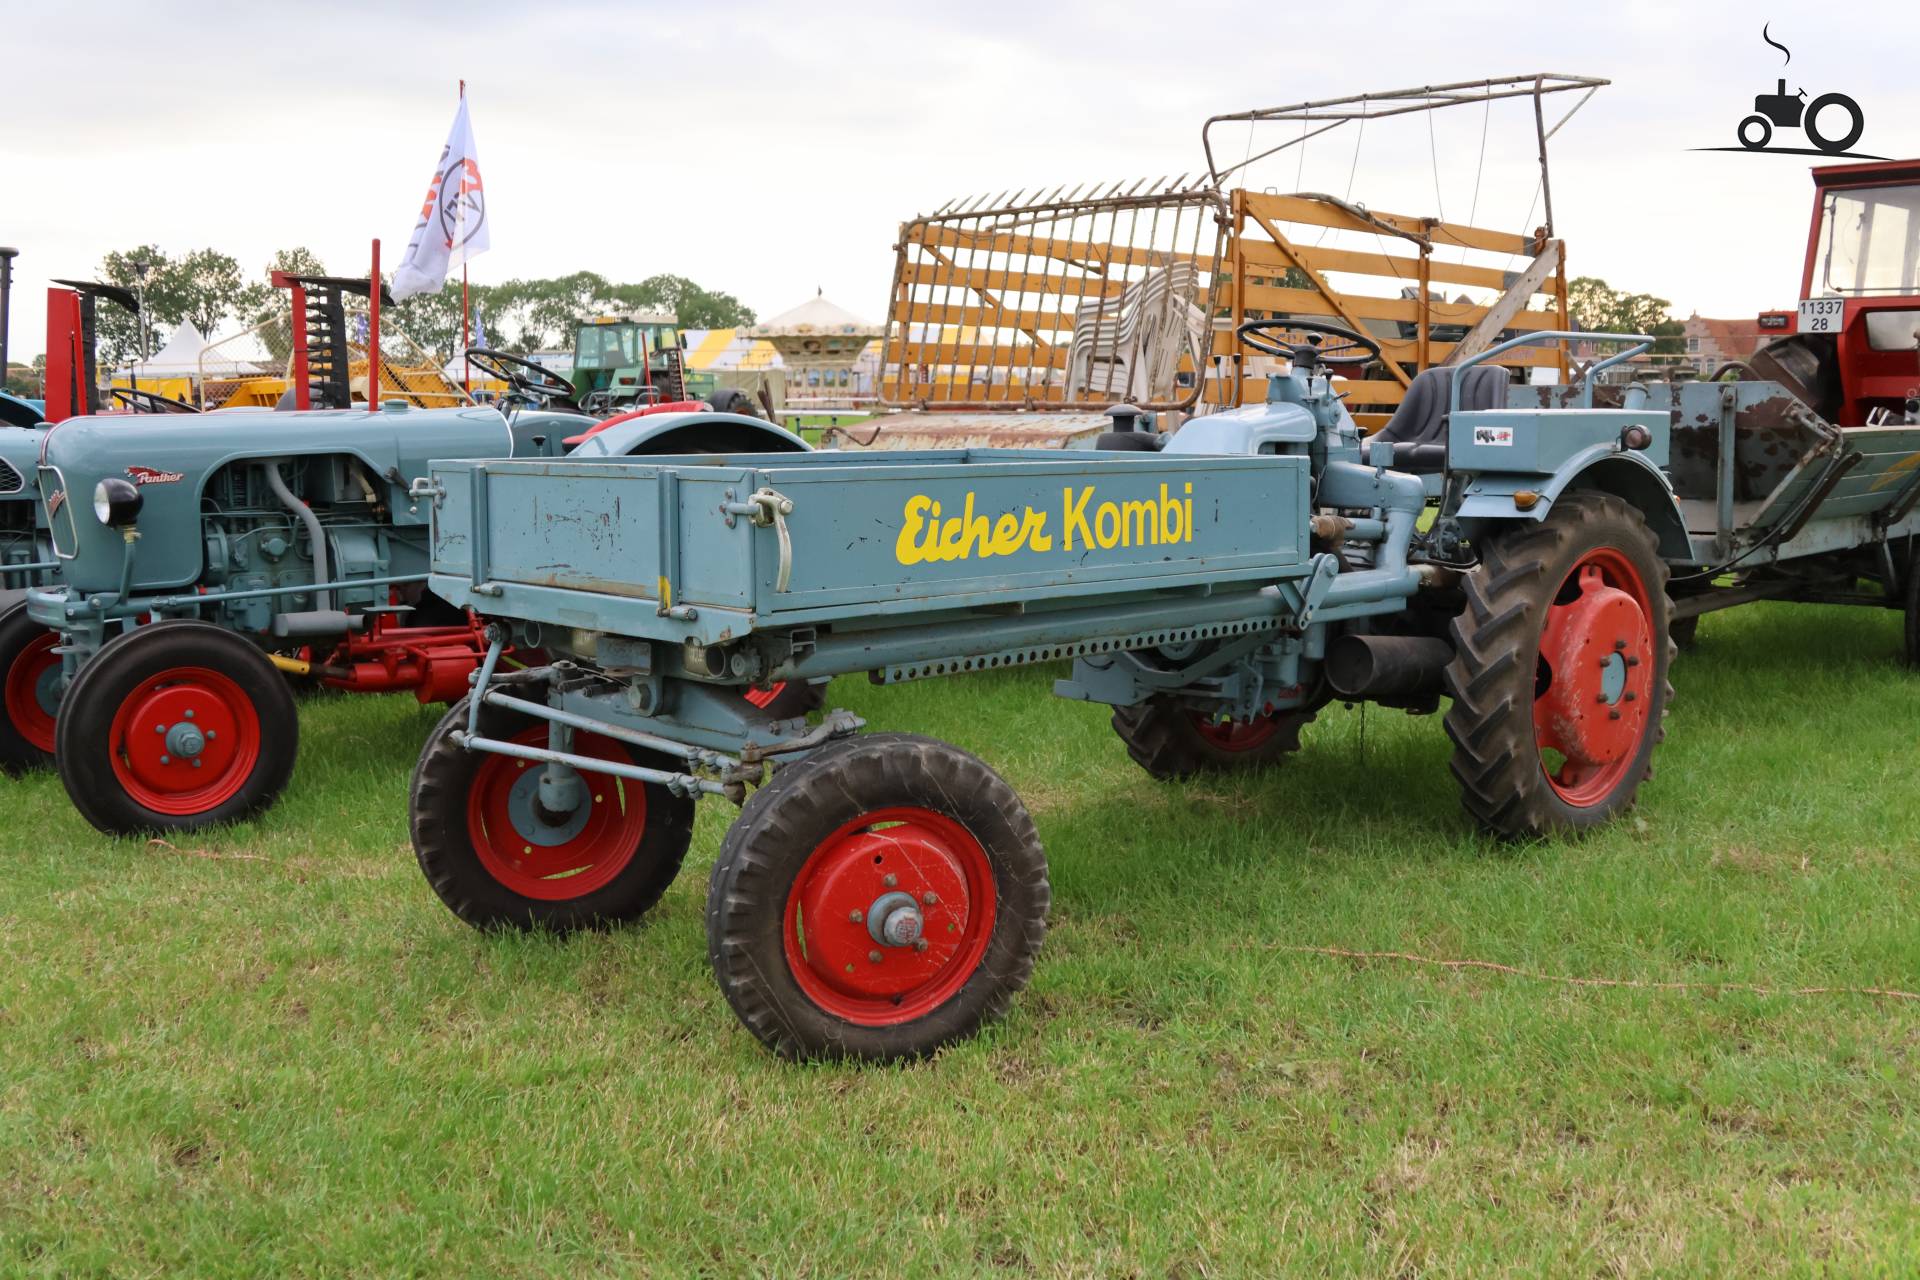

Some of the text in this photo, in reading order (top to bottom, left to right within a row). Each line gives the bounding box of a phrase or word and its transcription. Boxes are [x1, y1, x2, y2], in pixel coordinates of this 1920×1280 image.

[1801, 301, 1842, 314] 11337
[1812, 318, 1828, 331] 28
[137, 471, 184, 483] Panther
[896, 482, 1192, 565] Eicher Kombi
